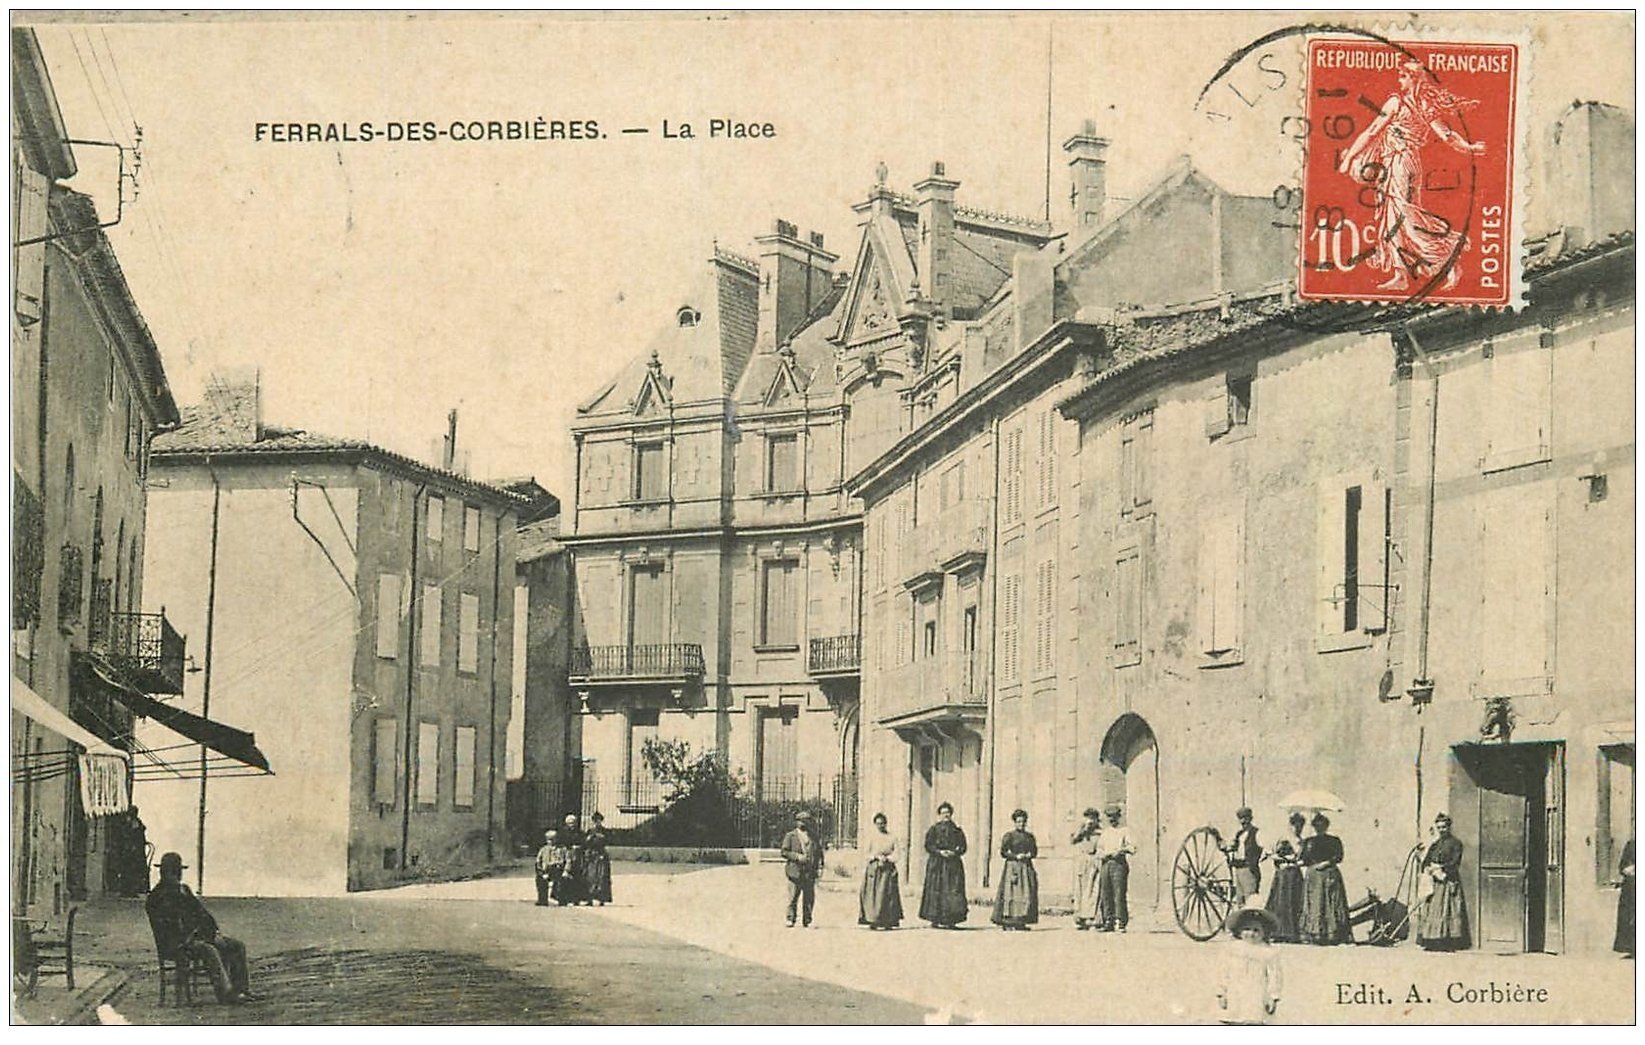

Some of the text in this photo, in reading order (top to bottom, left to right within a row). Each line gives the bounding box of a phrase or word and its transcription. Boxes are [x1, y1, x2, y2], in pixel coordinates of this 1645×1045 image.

[1316, 49, 1509, 74] REPUBLIQUE FRANÇAISE
[1481, 204, 1502, 289] POSTES
